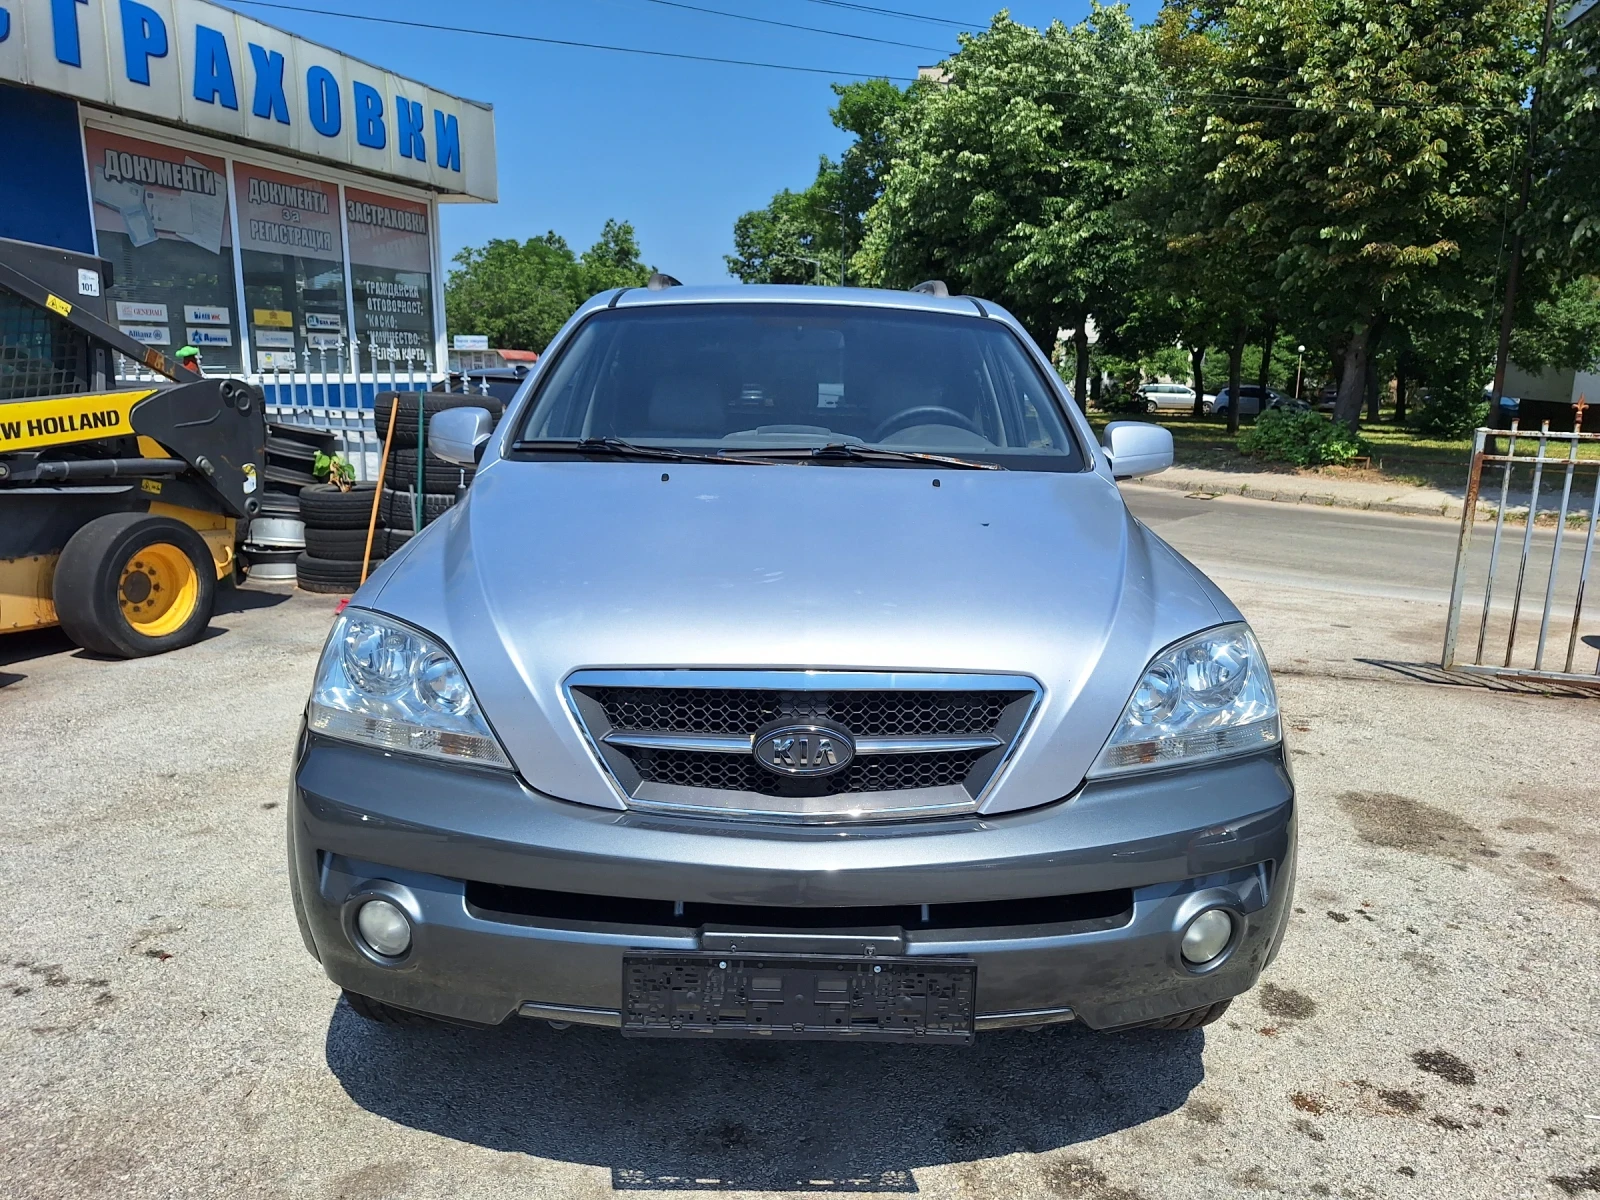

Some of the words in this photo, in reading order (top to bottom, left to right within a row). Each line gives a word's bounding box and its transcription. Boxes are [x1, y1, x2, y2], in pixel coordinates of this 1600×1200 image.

[0, 0, 461, 173] ТРАХОВКИ
[104, 149, 217, 196] ДОКУМЕНТИ
[248, 177, 330, 214] ДОКУМЕНТИ
[282, 209, 300, 222] за
[347, 200, 426, 234] ЗАСТРАХОВКИ
[250, 219, 332, 251] РЕГИСТРАЦИЯ
[82, 283, 93, 292] 101
[133, 308, 163, 316] GENERALI
[128, 329, 152, 339] Allianz
[27, 409, 120, 437] HOLLAND
[772, 738, 838, 765] KIA
